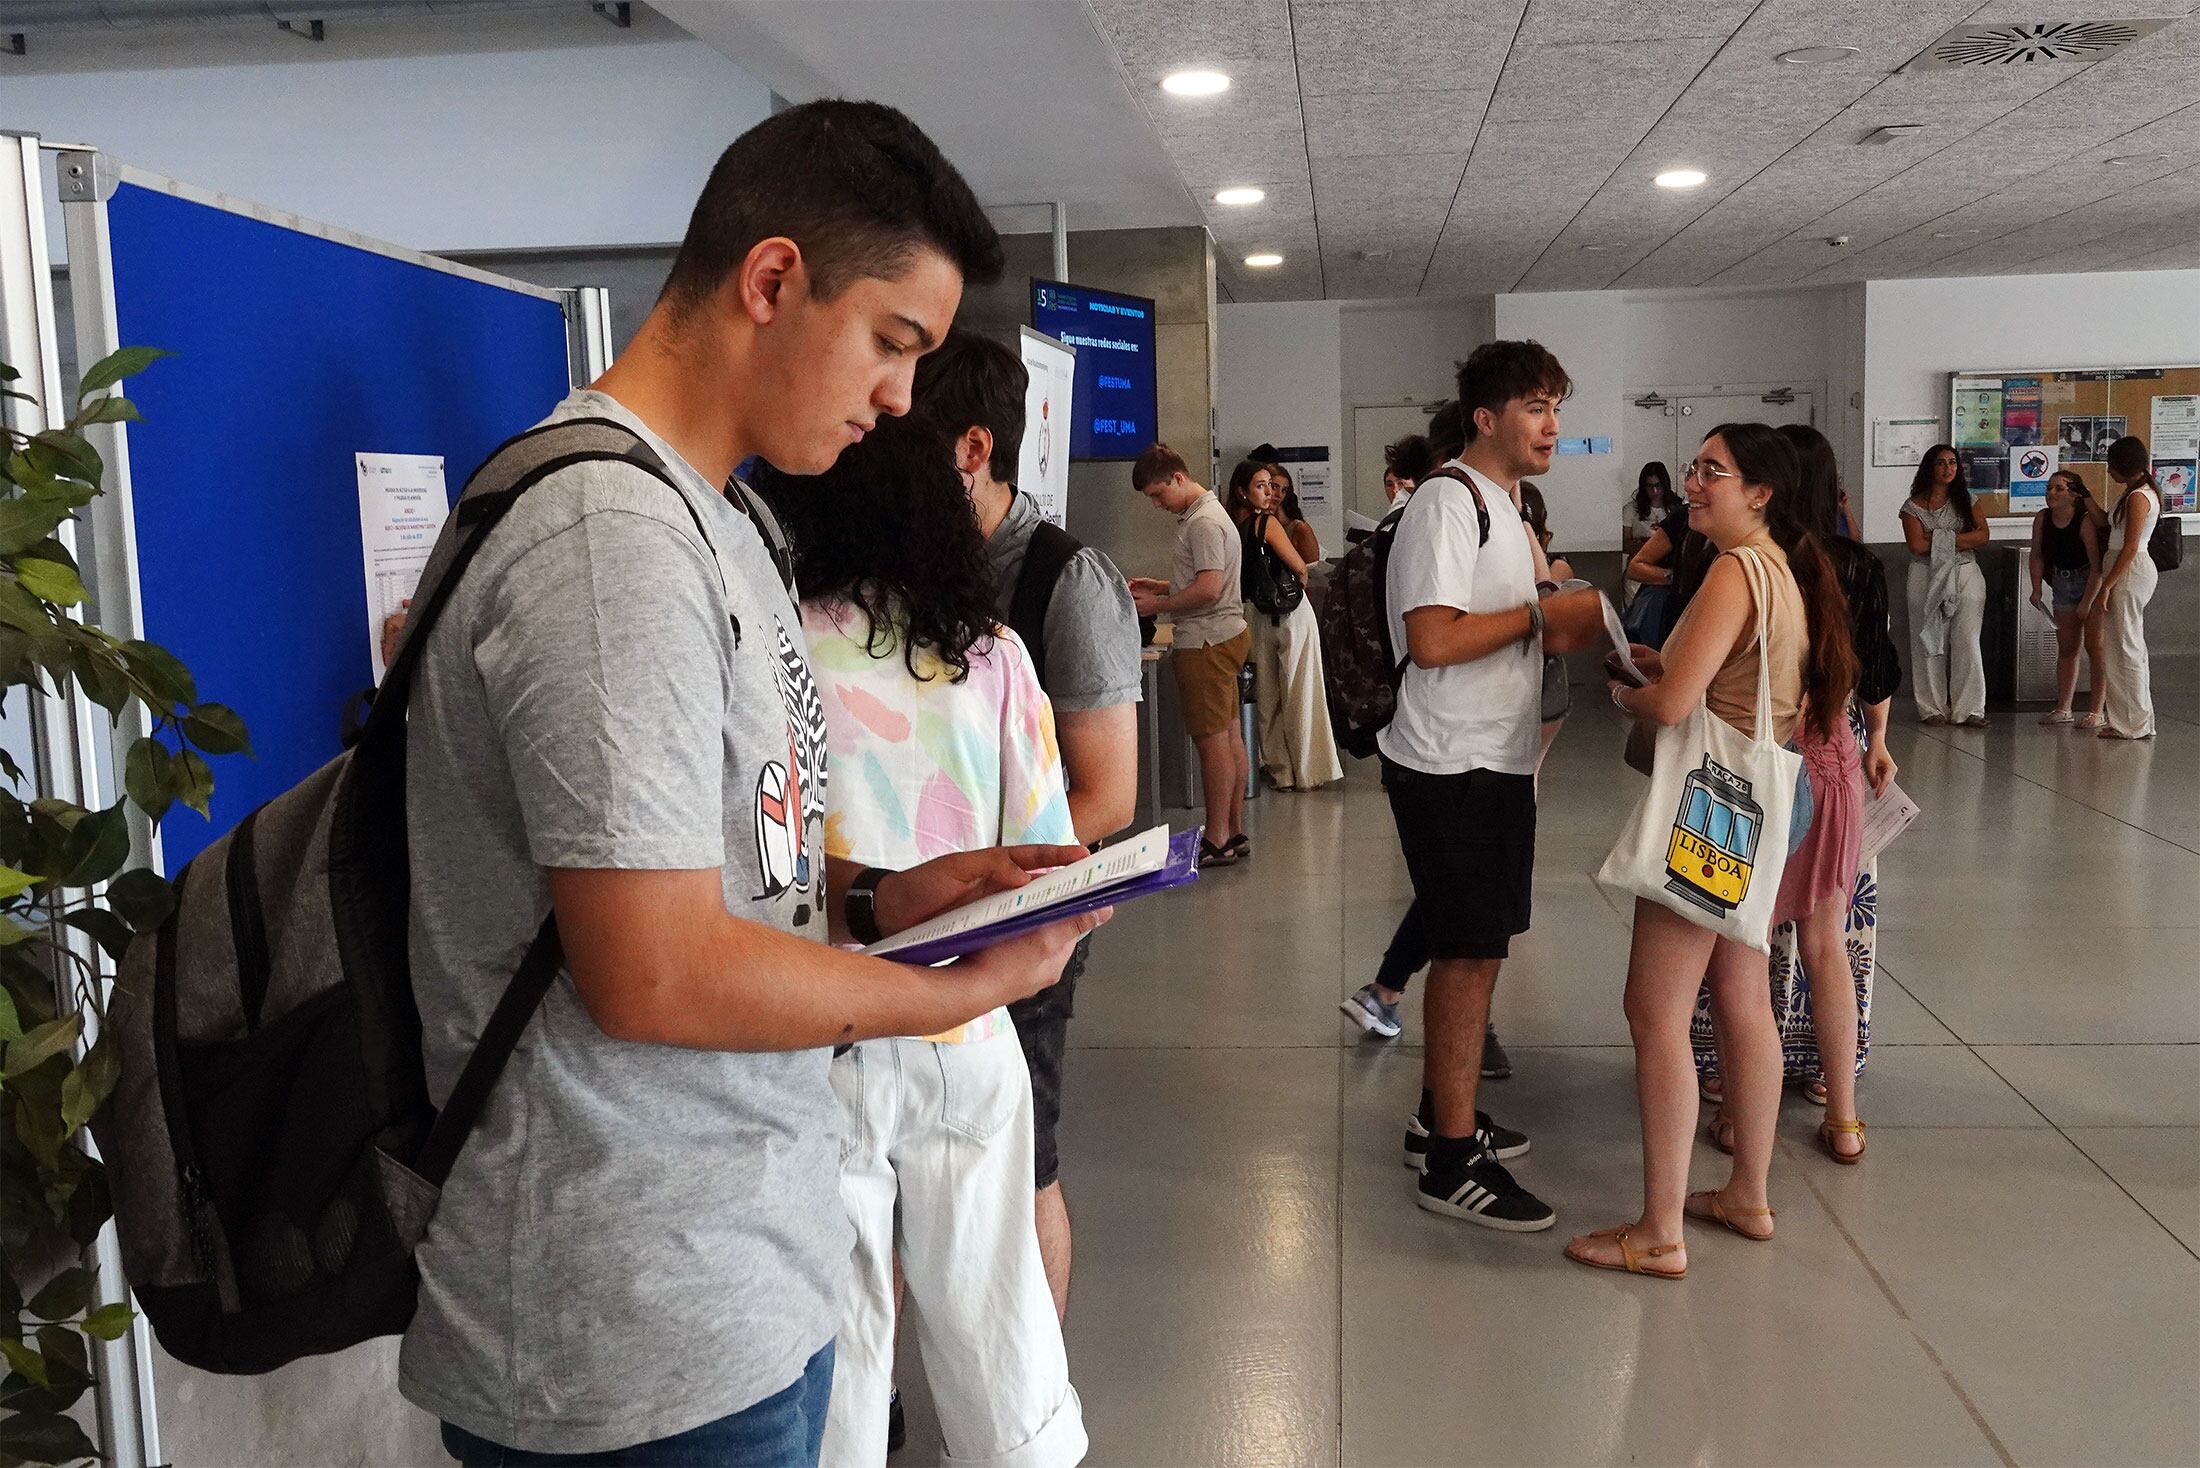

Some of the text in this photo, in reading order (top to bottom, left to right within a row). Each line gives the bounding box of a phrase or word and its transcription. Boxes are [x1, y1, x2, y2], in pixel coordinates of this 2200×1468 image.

[1060, 331, 1075, 346] Sigue
[1075, 336, 1097, 347] nuestras
[1097, 337, 1112, 349] redes
[1112, 339, 1131, 351] sociales
[1098, 375, 1132, 389] @FESTUMA
[1093, 418, 1136, 436] @FEST_UMA
[1679, 833, 1743, 880] LISBOA
